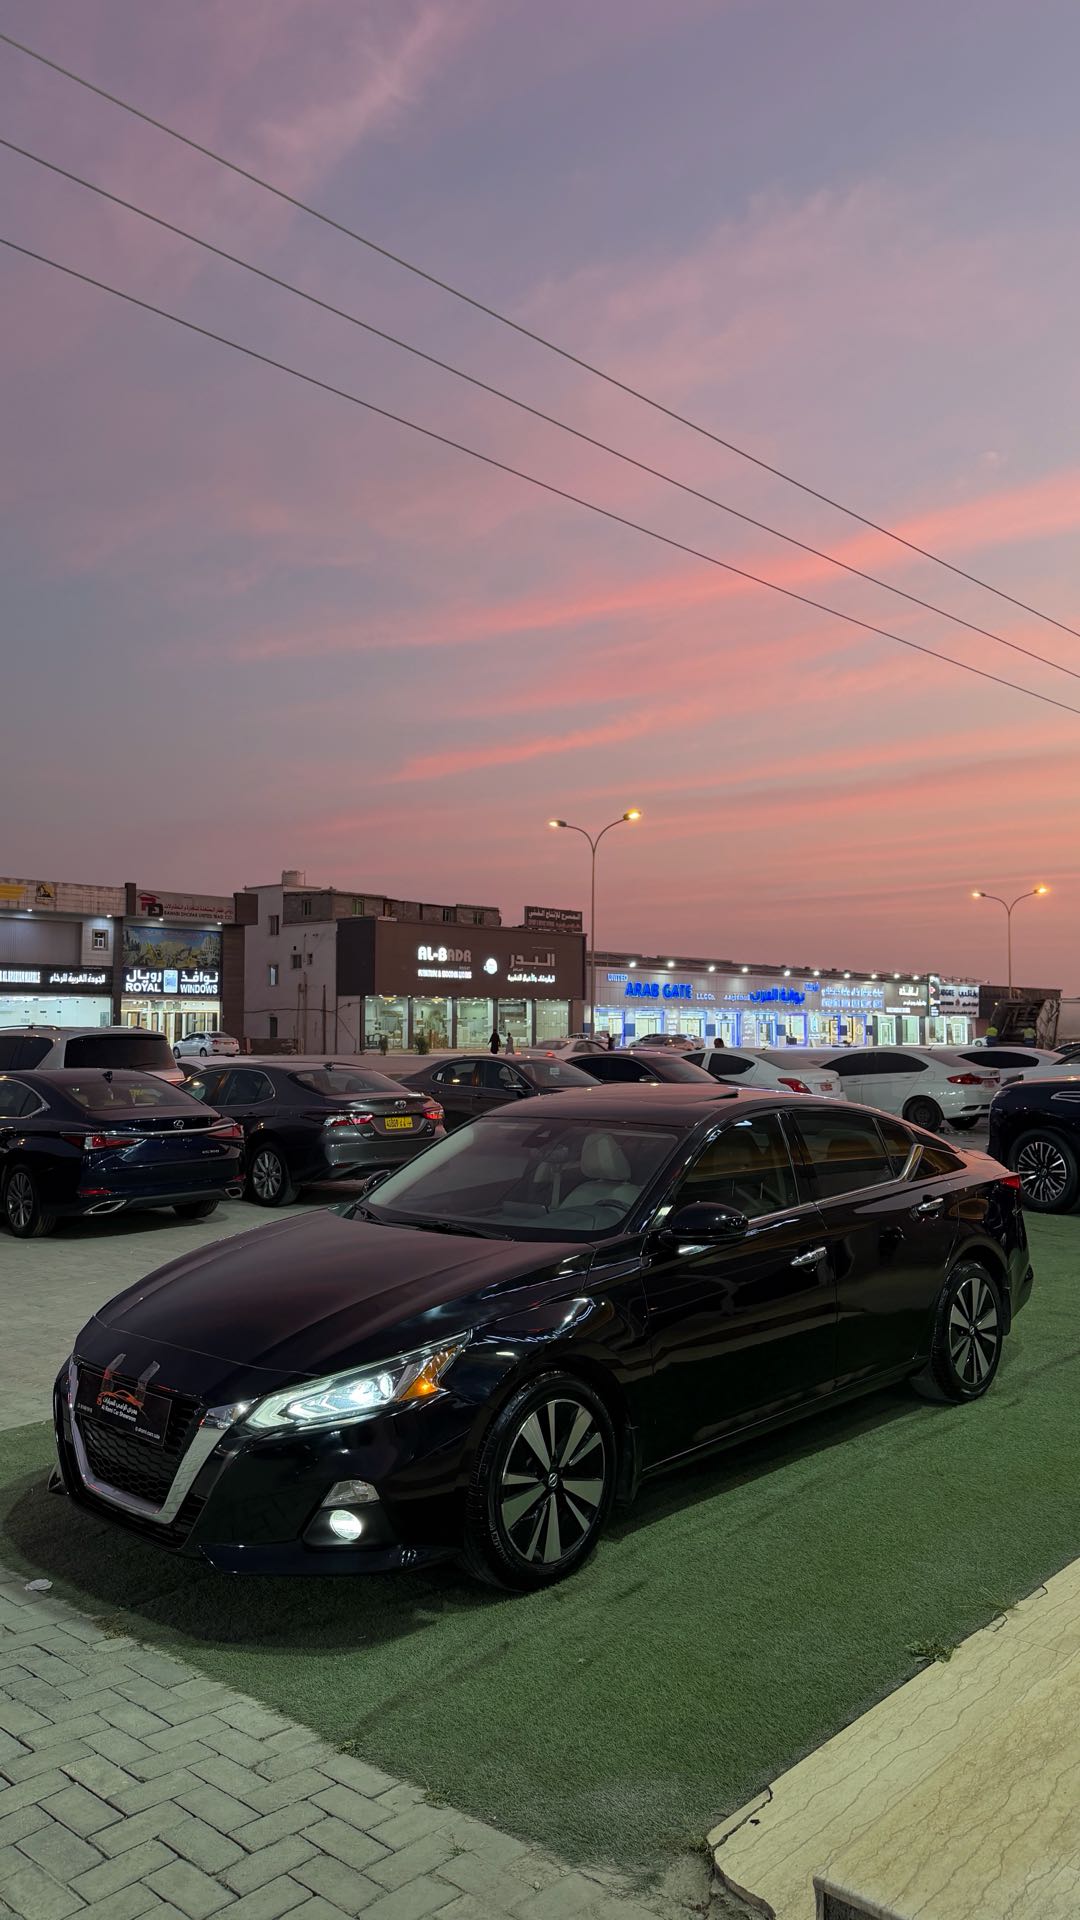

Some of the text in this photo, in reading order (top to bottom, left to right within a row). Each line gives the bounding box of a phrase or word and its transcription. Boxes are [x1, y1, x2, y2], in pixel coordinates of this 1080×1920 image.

[418, 946, 471, 962] AL-BADR
[510, 953, 555, 970] البدر
[126, 970, 218, 985] رويال نوافذ
[126, 982, 218, 994] ROYAL WINDOWS
[625, 982, 692, 1000] ARAB GATE
